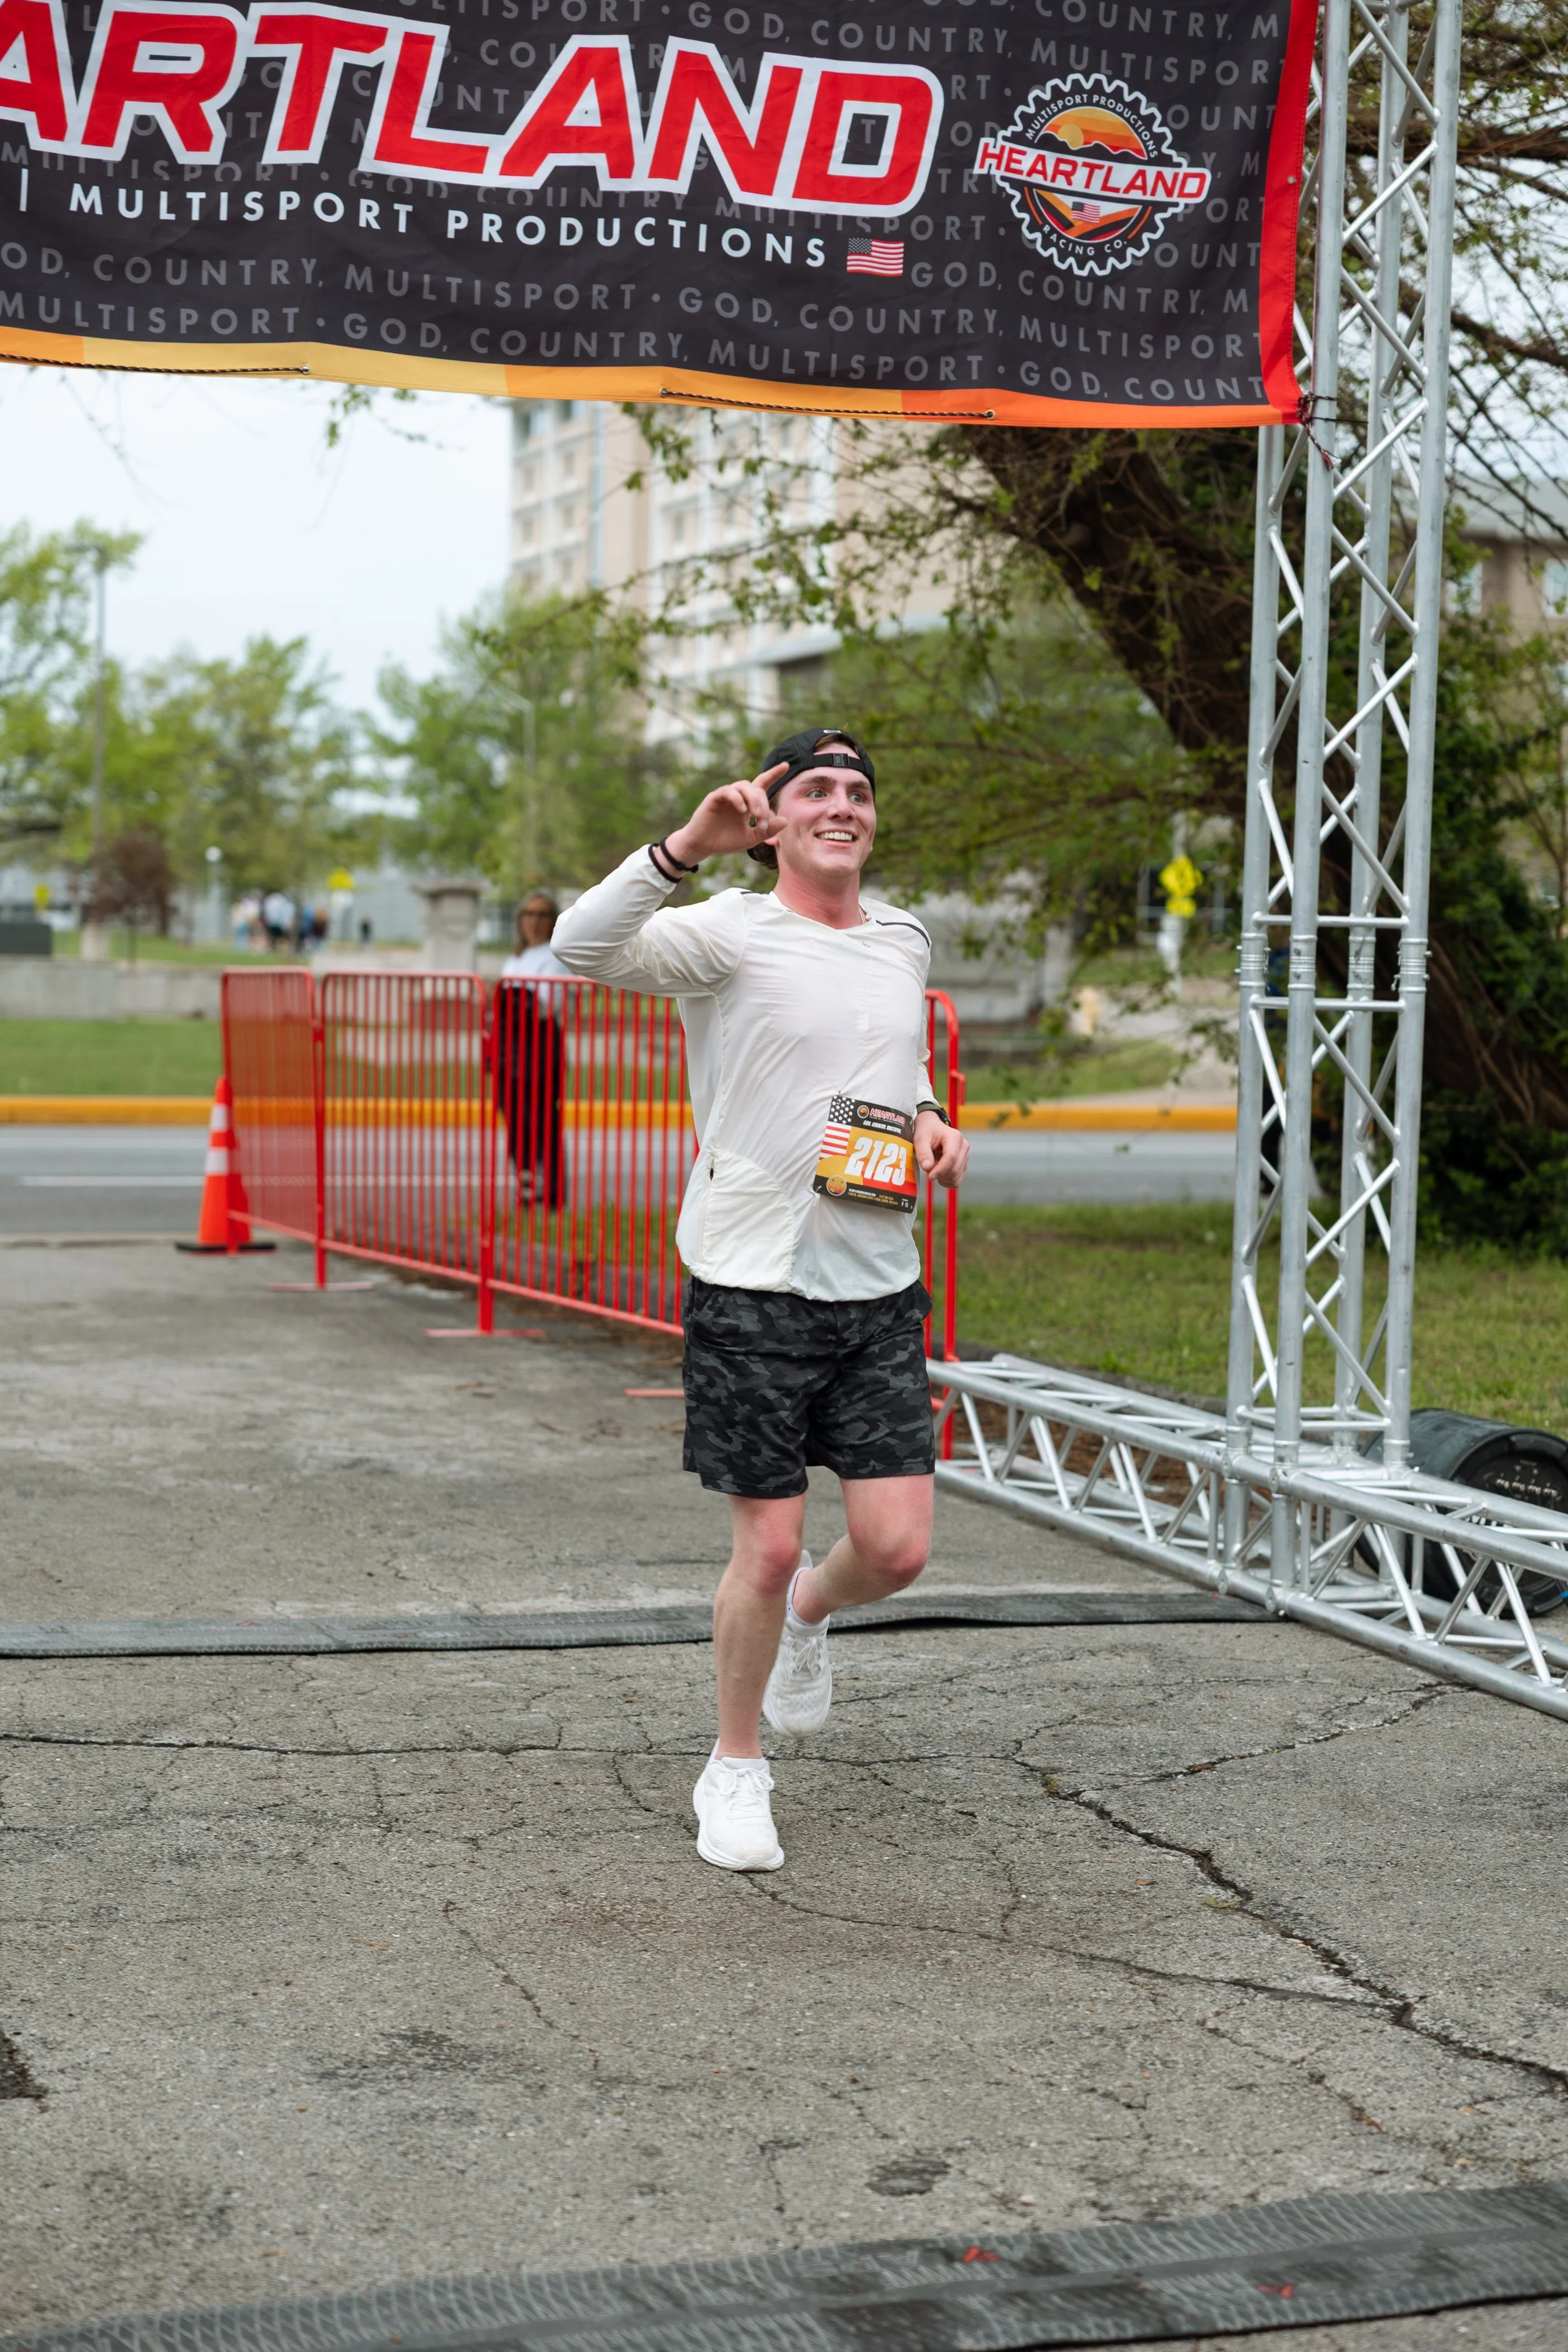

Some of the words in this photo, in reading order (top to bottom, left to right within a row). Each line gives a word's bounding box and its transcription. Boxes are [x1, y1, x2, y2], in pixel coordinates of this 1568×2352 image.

[689, 2, 790, 43] GOD,
[811, 19, 1014, 59] COUNTRY,
[1024, 93, 1089, 140] MULTISPORT
[1093, 95, 1158, 159] PRODUCTIONS
[1147, 102, 1276, 130] OUNT
[975, 139, 1210, 203] HEARTLAND
[70, 183, 413, 233] MULTISPORT
[447, 209, 826, 267] PRODUCTIONS
[1042, 223, 1095, 256] RACING
[1131, 243, 1261, 268] OUNT
[93, 253, 324, 289] COUNTRY,
[344, 263, 635, 310] MULTISPORT
[679, 287, 778, 327] GOD,
[800, 304, 1004, 337] COUNTRY,
[911, 262, 1002, 291] GOD,
[1018, 270, 1205, 315] COUNTRY,
[0, 290, 300, 335] MULTISPORT
[343, 313, 448, 352] GOD,
[470, 327, 689, 363] COUNTRY,
[708, 339, 983, 381] MULTISPORT
[1020, 361, 1108, 399] GOD,
[844, 1136, 906, 1186] 2123
